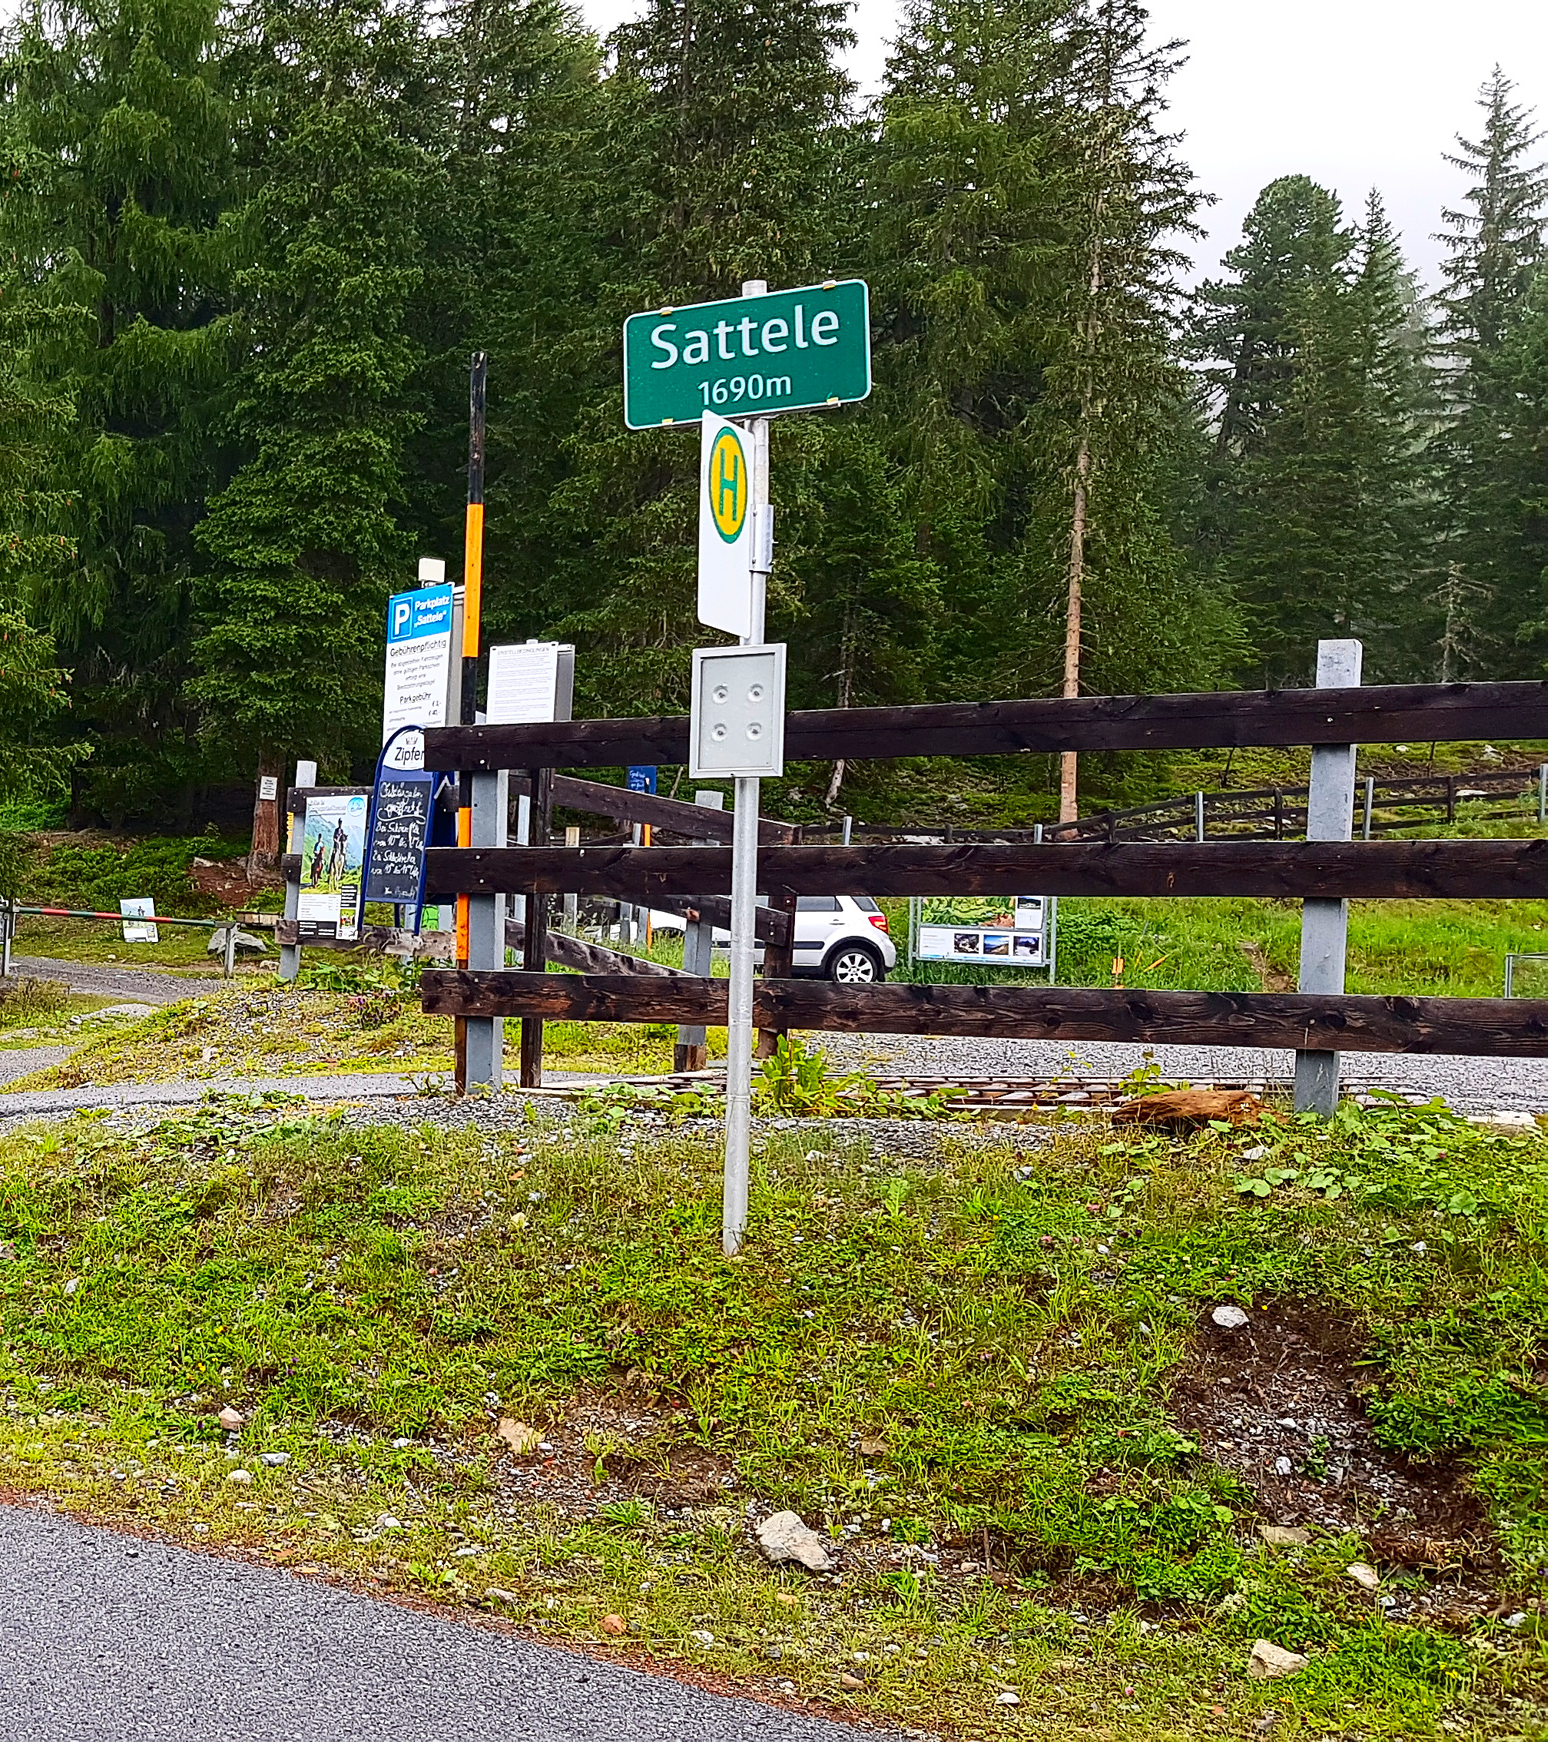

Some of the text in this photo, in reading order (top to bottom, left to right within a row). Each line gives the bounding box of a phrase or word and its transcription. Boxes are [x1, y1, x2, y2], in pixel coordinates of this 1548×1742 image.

[650, 303, 840, 370] Sattele
[698, 374, 792, 406] 1690m
[719, 447, 739, 522] H
[414, 596, 450, 612] Parkplatz
[394, 603, 410, 636] P
[390, 639, 447, 657] Gebührenpflichtig
[399, 692, 432, 705] Parkgebühr
[394, 746, 425, 767] Zipfer
